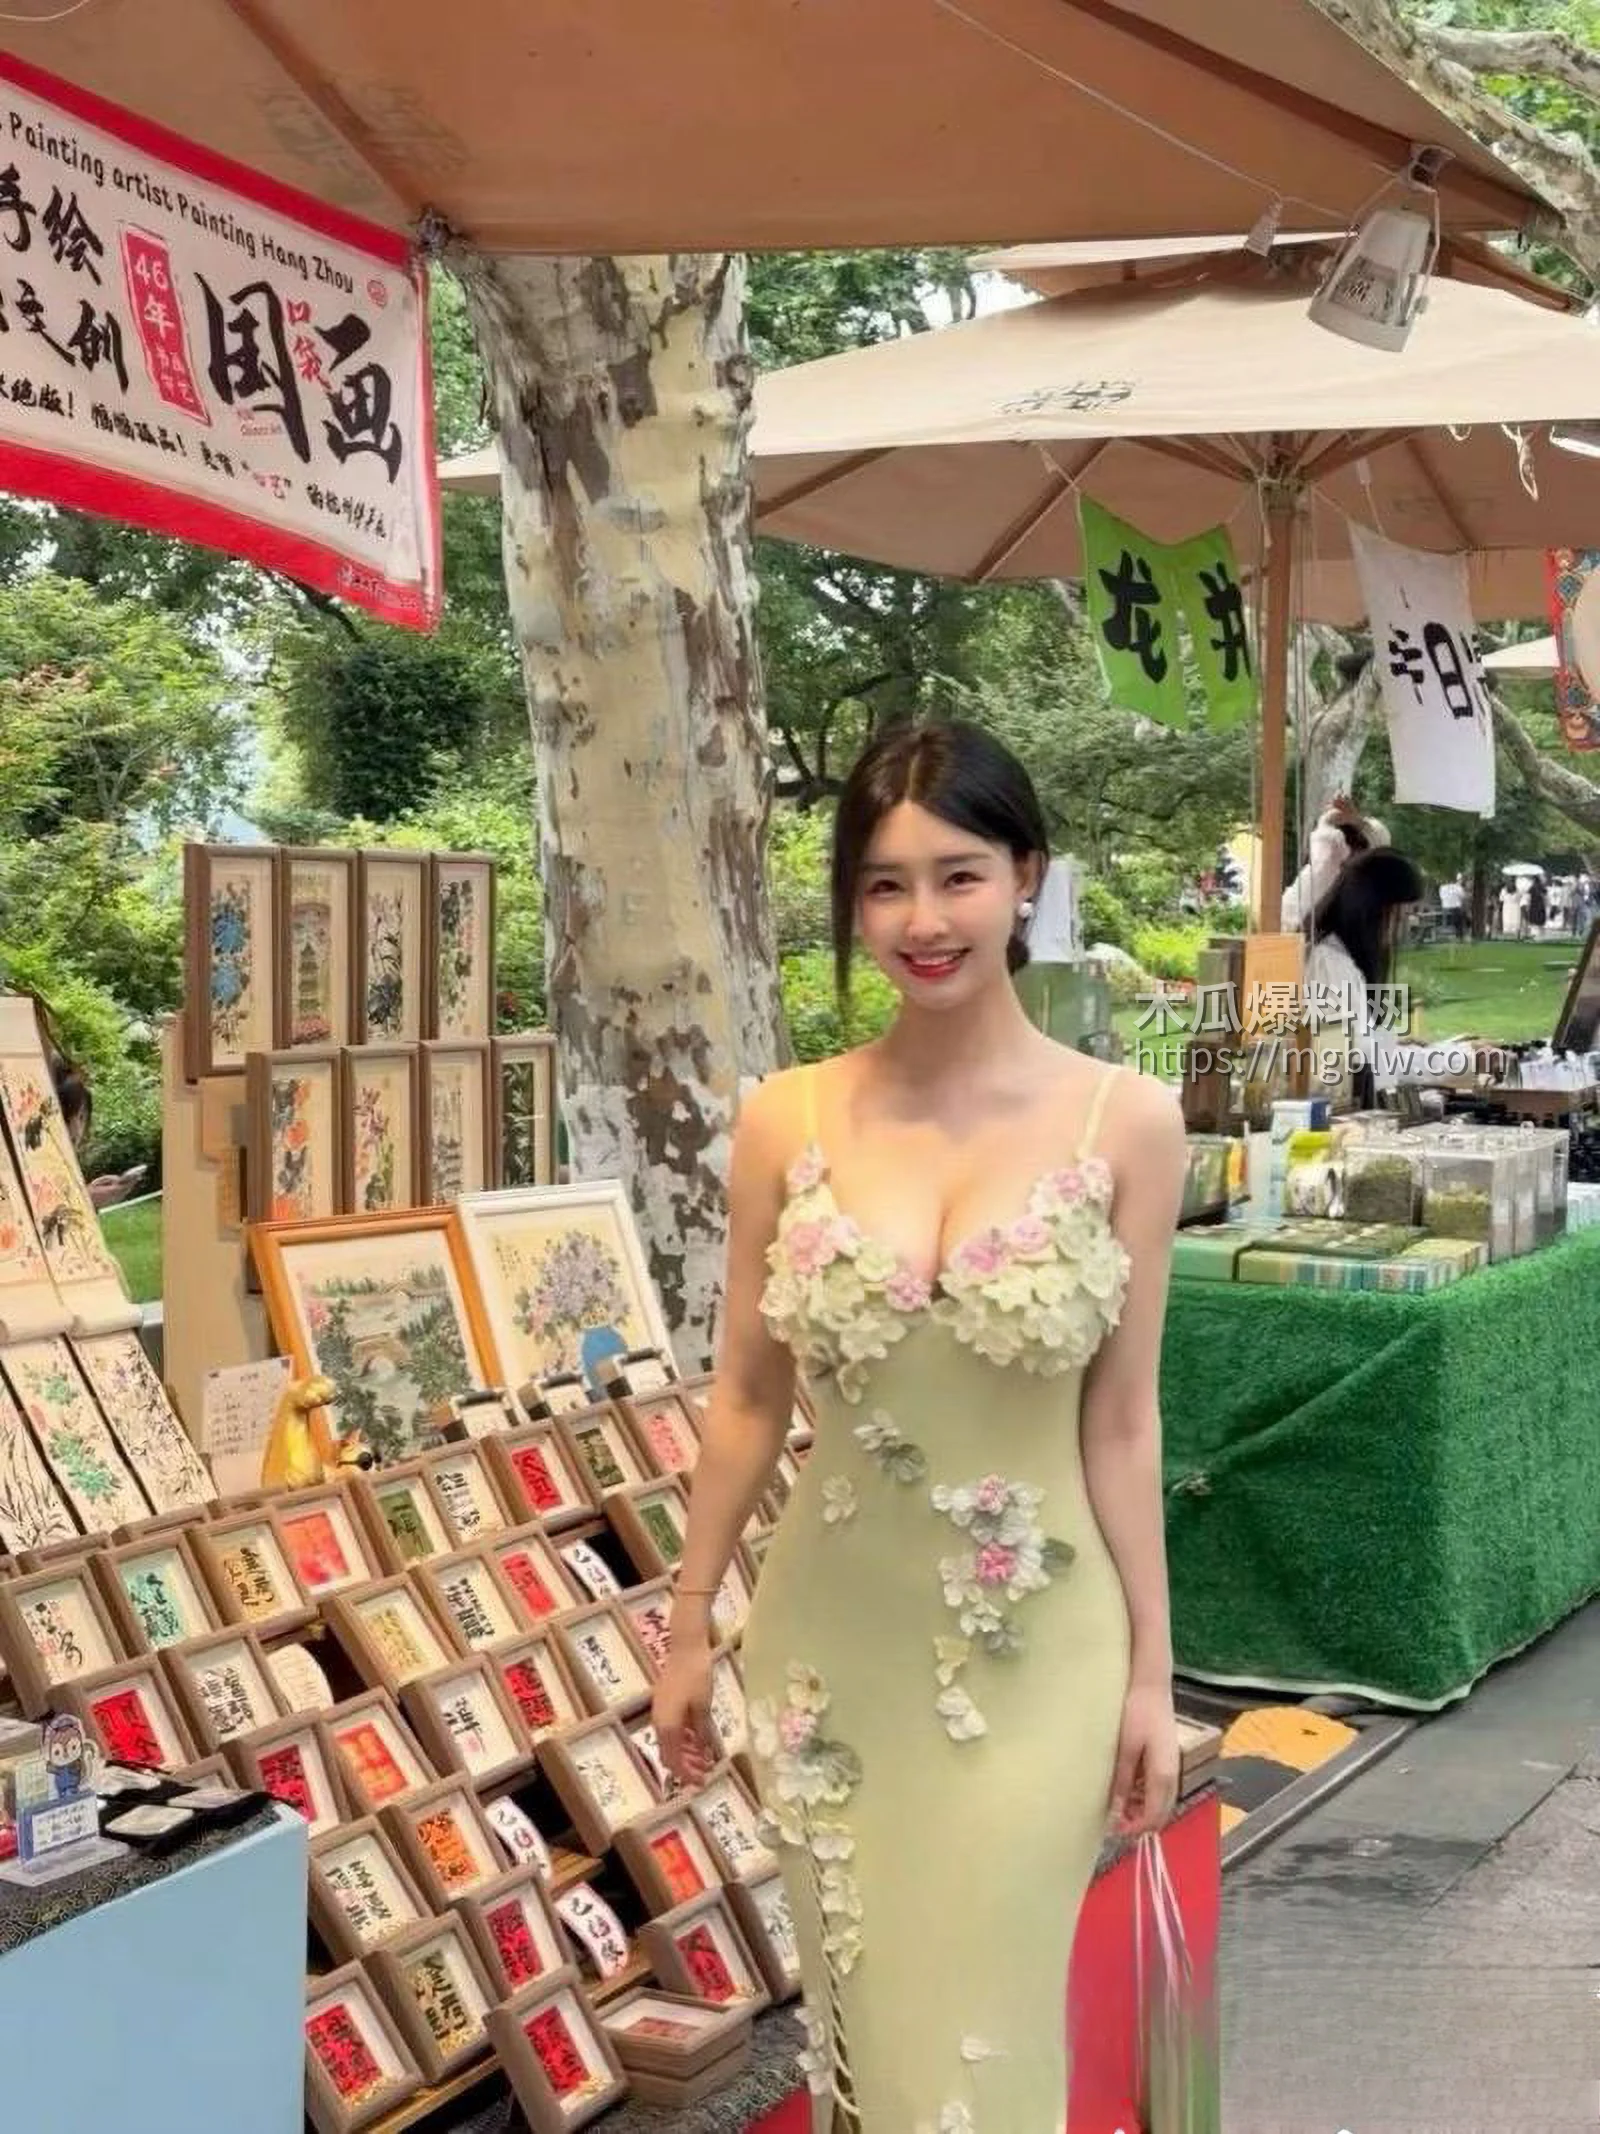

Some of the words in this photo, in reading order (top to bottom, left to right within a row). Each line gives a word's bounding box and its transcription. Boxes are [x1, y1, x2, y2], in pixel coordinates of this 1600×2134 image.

[10, 111, 104, 187] Painting
[113, 166, 173, 212] artist
[178, 193, 257, 259] Painting
[261, 233, 308, 280] Hang
[312, 255, 354, 294] Zhou
[1098, 548, 1251, 684] 龙井
